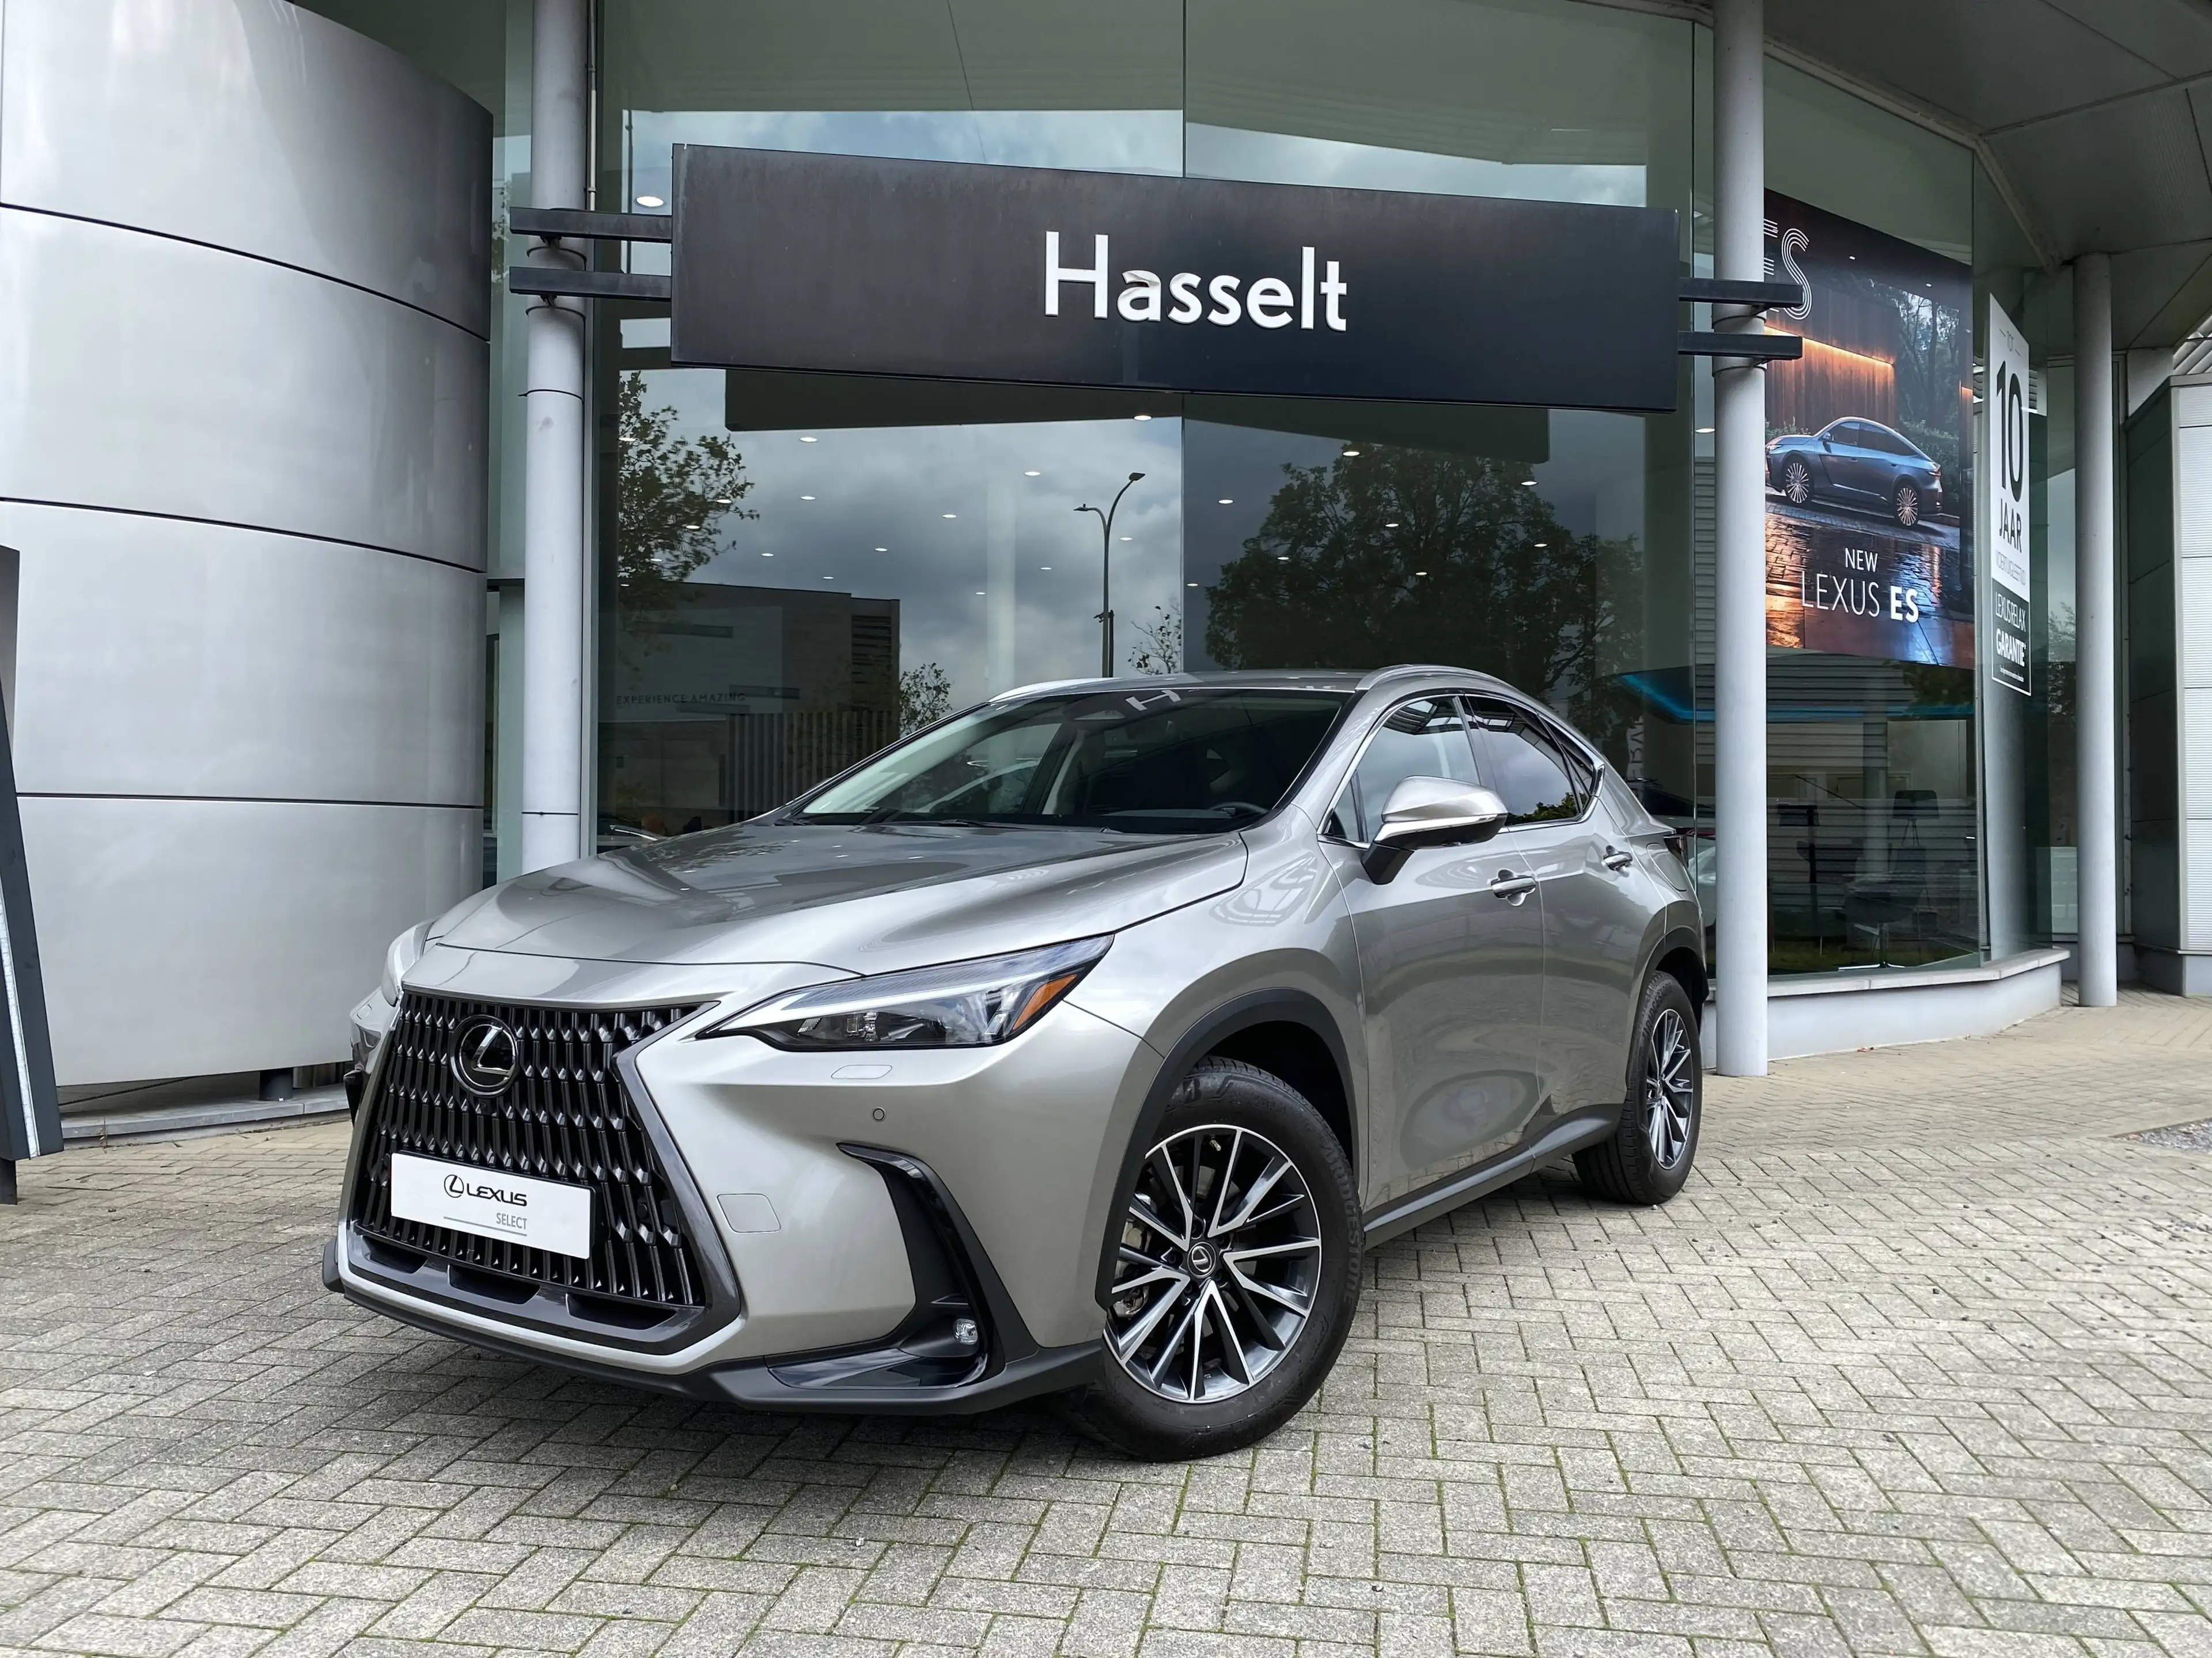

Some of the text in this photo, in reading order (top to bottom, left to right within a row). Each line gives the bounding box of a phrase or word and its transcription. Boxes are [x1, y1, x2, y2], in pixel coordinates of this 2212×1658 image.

[1044, 231, 1347, 332] Hasselt
[1997, 360, 2023, 503] 10
[1999, 498, 2022, 553] JAAR
[1845, 548, 1878, 572] NEW
[1802, 571, 1919, 623] LEXUS ES
[616, 693, 746, 705] EXPERIENCE AMAZING
[467, 1183, 527, 1206] LEXUS
[496, 1212, 528, 1230] SELECT
